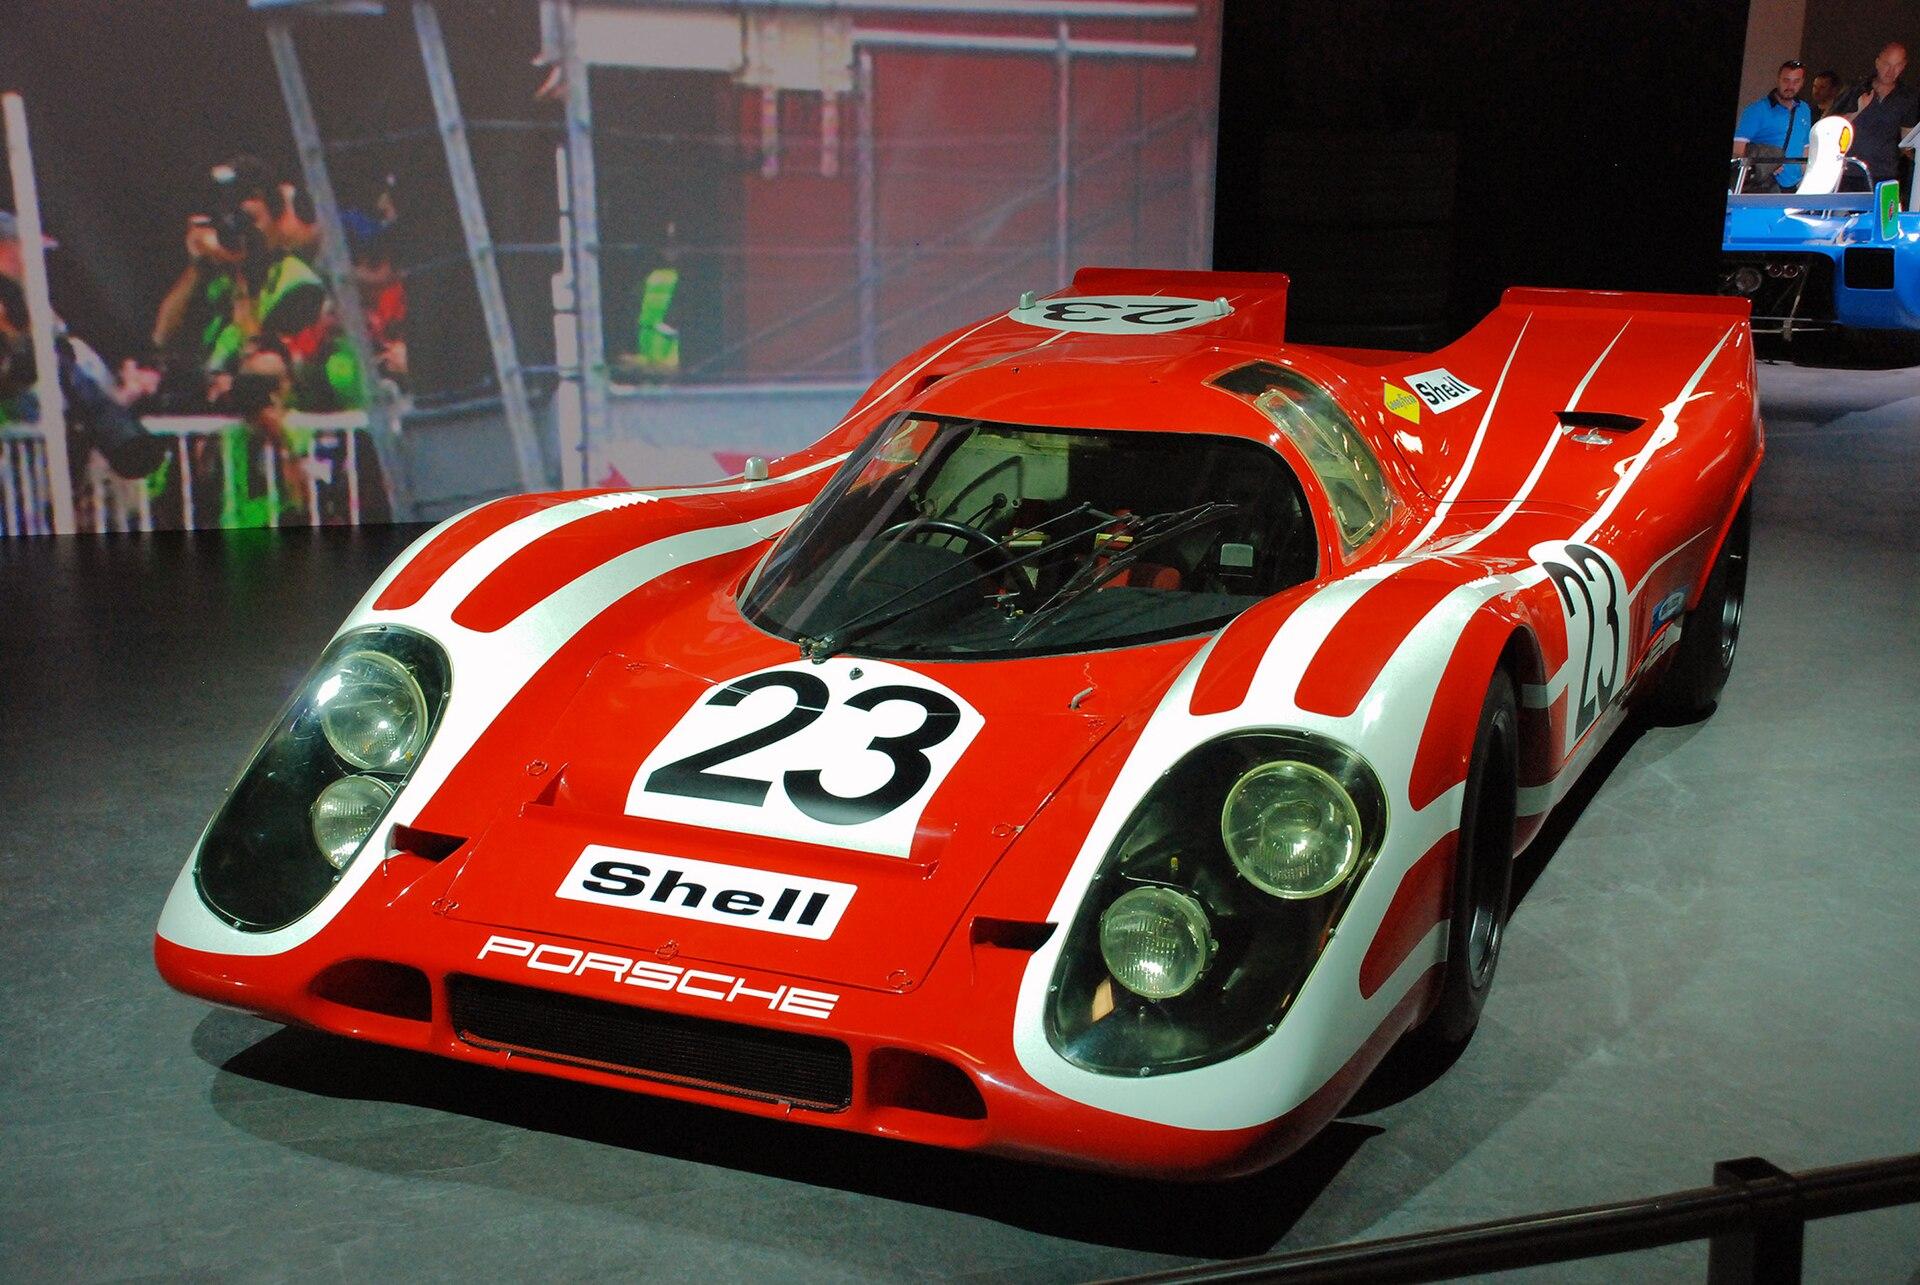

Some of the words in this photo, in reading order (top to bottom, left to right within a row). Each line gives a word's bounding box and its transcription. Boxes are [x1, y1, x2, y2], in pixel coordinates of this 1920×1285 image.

[1043, 302, 1198, 325] 23
[1415, 376, 1471, 405] Shell
[1542, 544, 1619, 741] 23
[644, 670, 961, 826] 23
[582, 860, 830, 926] Shell
[477, 935, 840, 1019] PORSCHE
